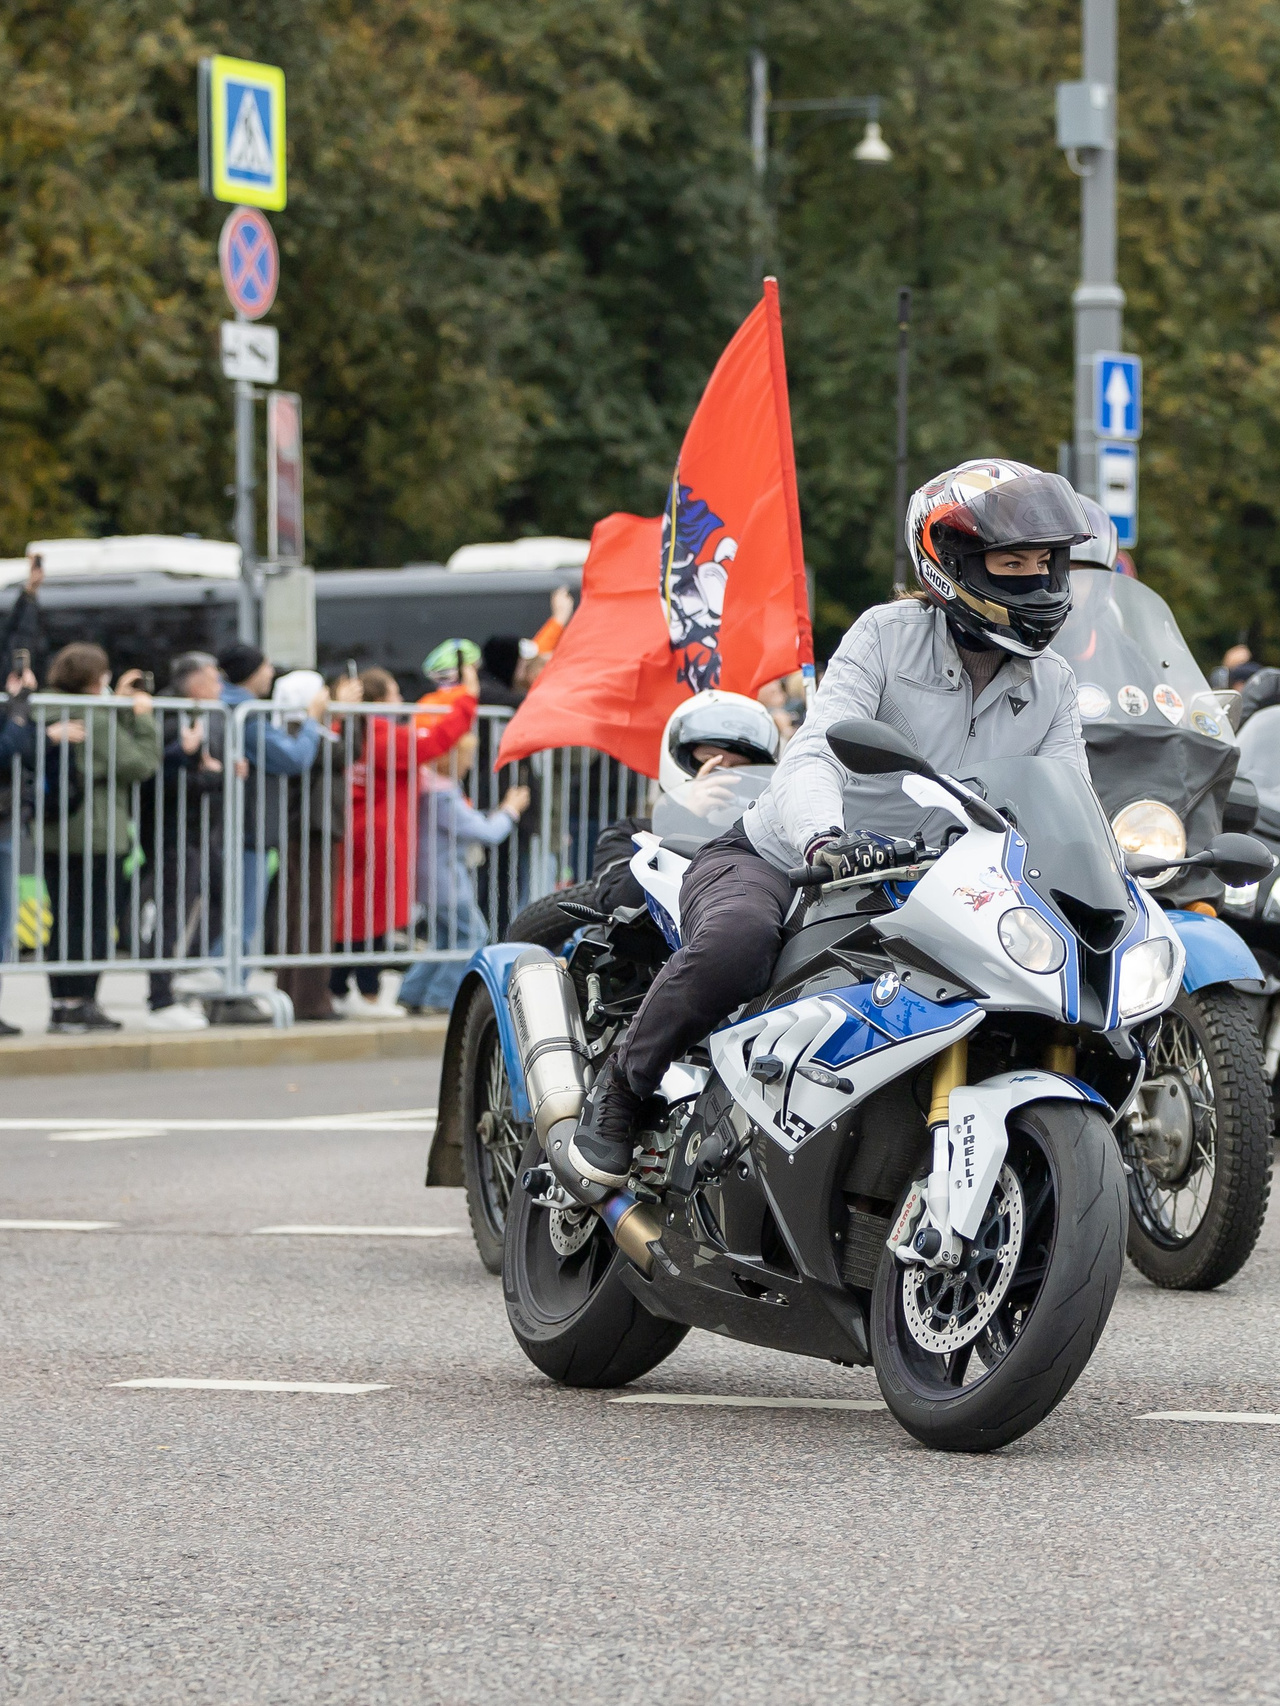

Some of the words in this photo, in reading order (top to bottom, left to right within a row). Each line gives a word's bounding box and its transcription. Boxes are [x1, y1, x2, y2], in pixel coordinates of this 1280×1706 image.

[925, 564, 950, 596] SHOEI
[963, 1114, 975, 1189] PIRELLI
[892, 1194, 917, 1242] brembo
